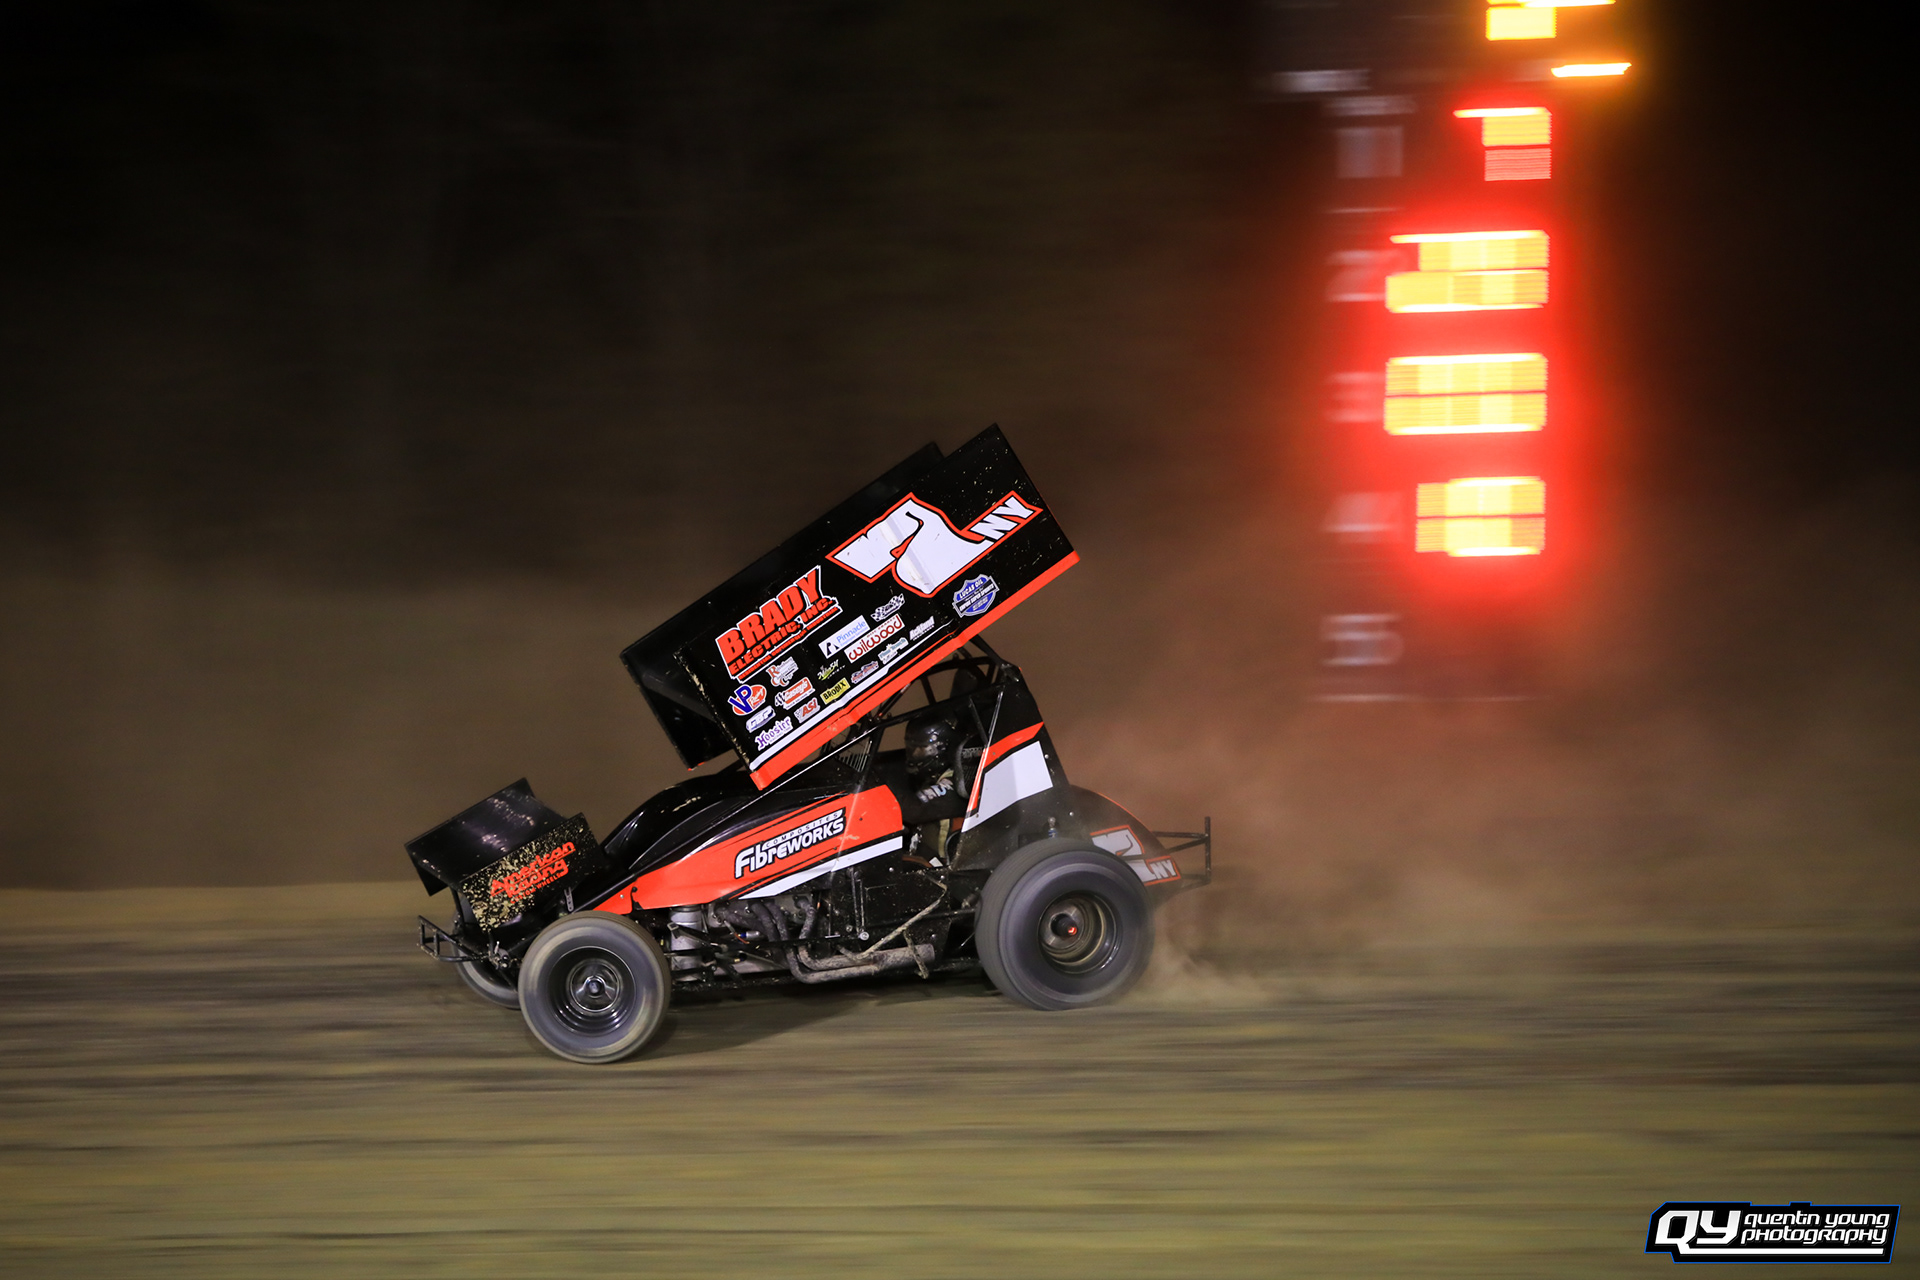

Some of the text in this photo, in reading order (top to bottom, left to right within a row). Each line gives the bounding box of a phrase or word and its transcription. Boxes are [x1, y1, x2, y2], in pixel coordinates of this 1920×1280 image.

[969, 496, 1034, 541] NY
[717, 569, 819, 664] BRADY
[800, 597, 834, 623] INC.
[836, 620, 867, 644] Pinnacle
[848, 615, 903, 661] wilwood
[729, 685, 753, 714] VP
[822, 680, 847, 700] BRODIX
[756, 719, 790, 748] Hoosier
[765, 813, 838, 848] COMPOSITES
[490, 842, 576, 897] American
[506, 859, 569, 898] Racing
[1149, 859, 1177, 880] NY
